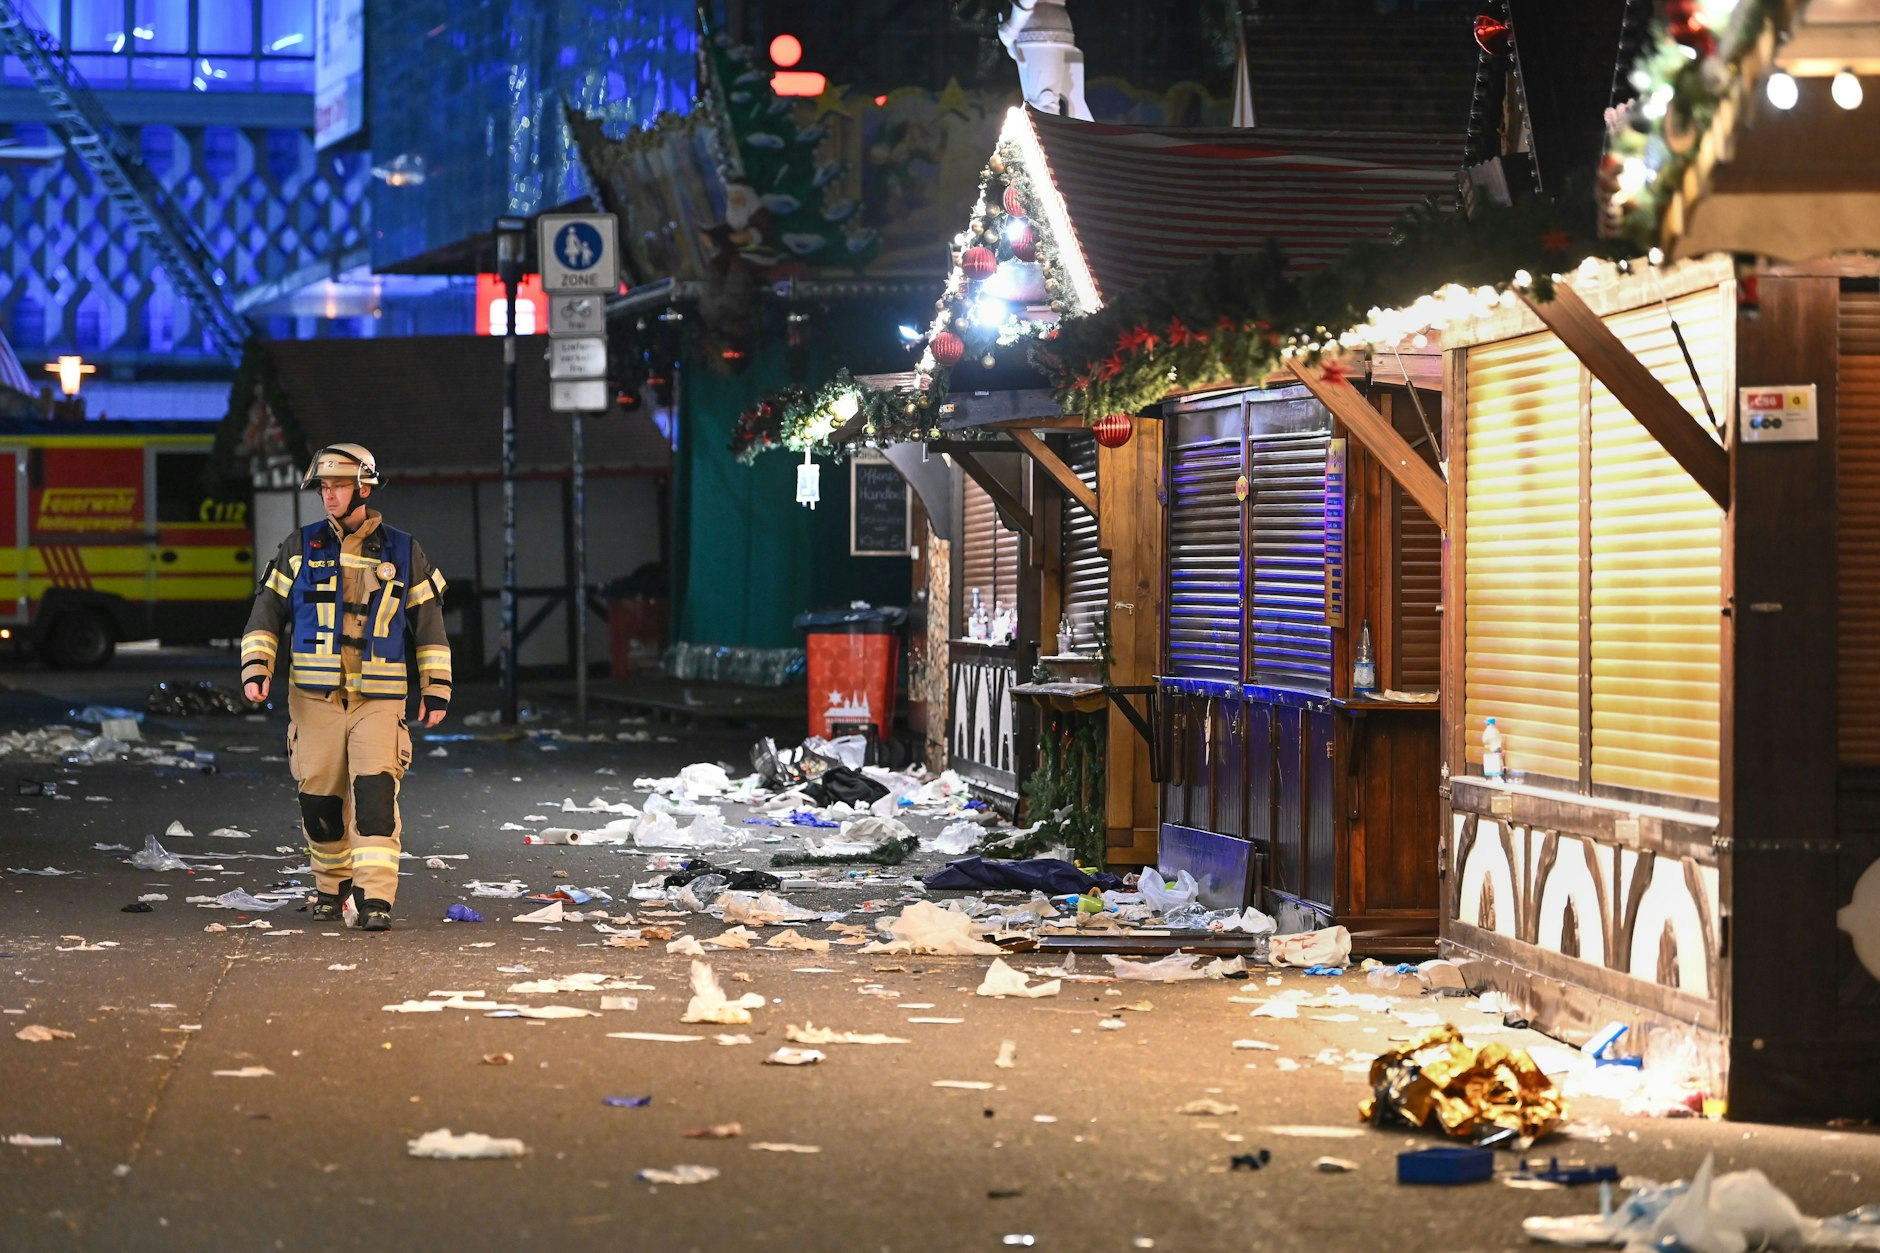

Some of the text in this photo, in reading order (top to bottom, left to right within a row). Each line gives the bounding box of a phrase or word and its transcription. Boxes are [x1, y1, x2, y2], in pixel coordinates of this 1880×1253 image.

[561, 273, 598, 287] ZONE
[328, 460, 334, 468] 2
[40, 487, 137, 513] Feuerwehr
